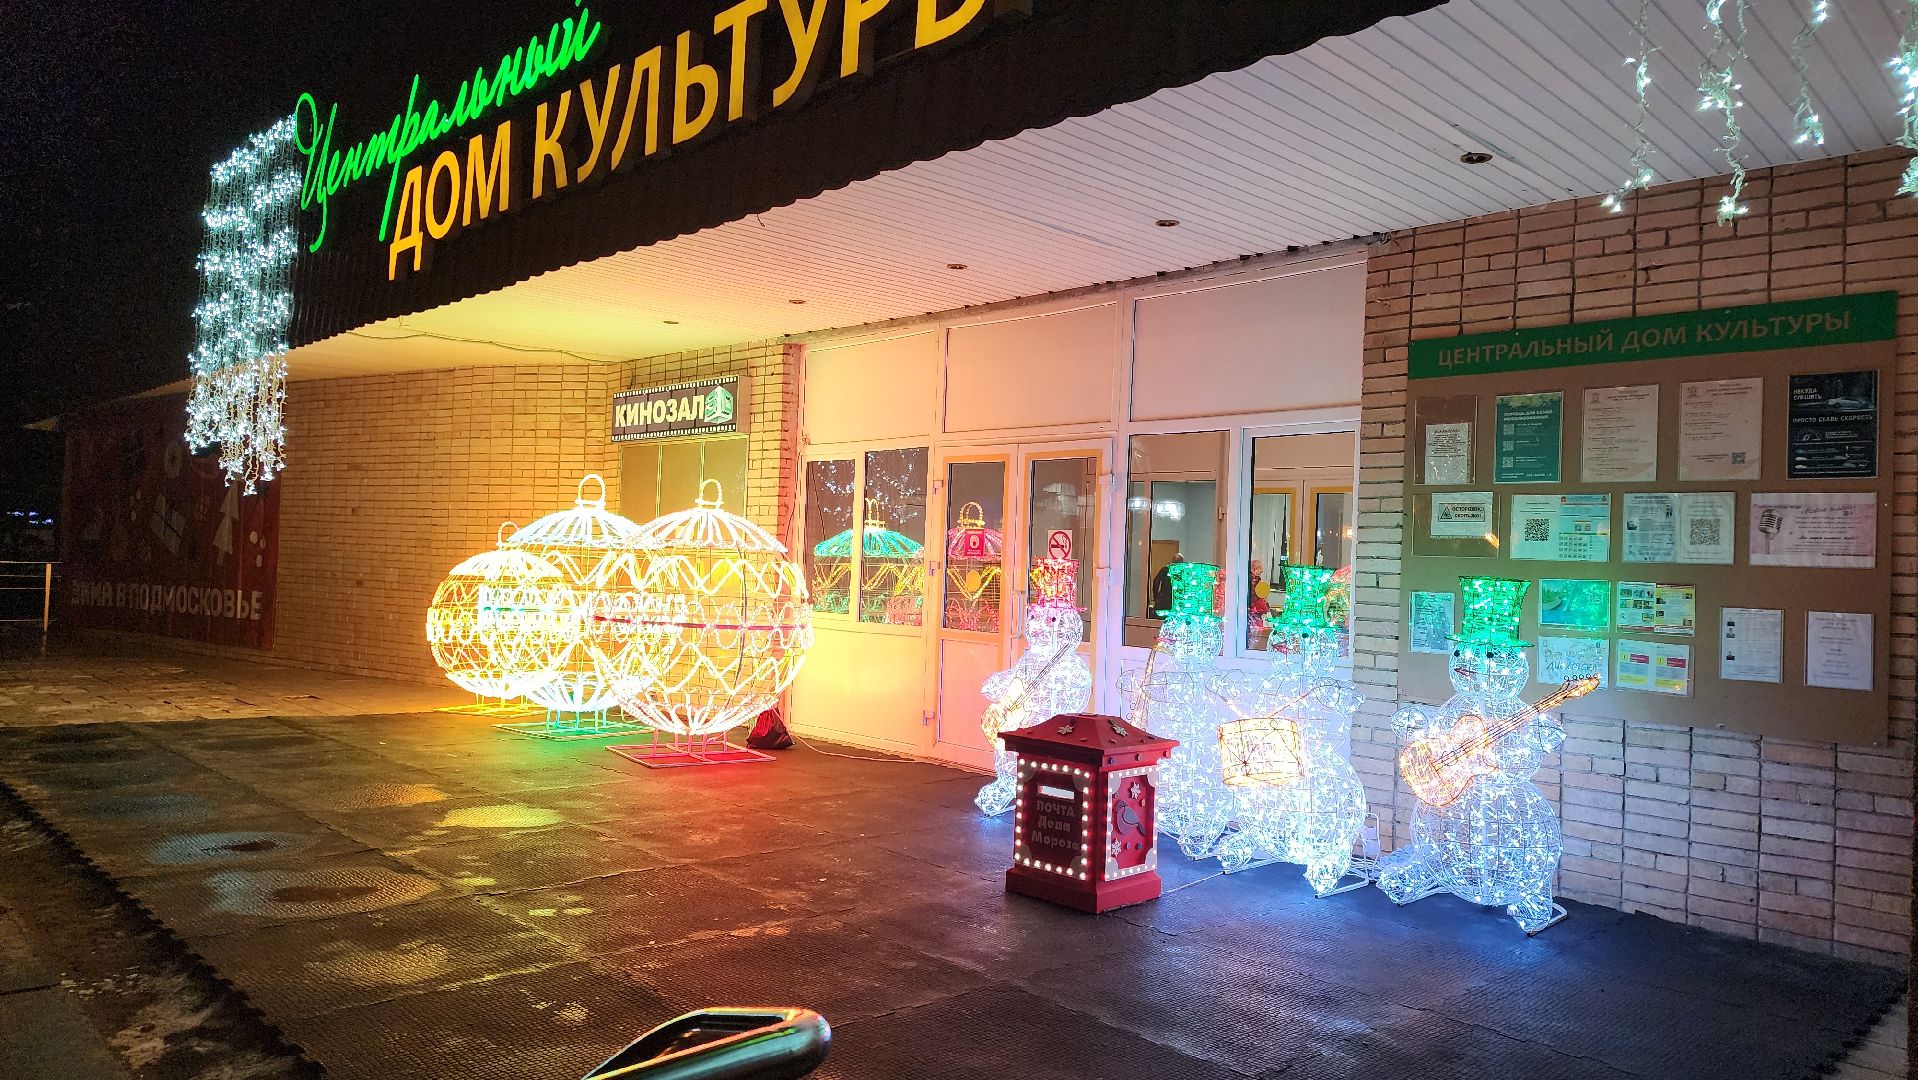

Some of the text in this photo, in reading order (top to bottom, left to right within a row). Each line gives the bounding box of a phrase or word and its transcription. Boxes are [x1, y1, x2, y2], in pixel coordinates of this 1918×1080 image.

[295, 0, 601, 253] Центральный
[388, 120, 512, 281] ДОМ
[1438, 311, 1850, 370] ЦЕНТРАЛЬНЫЙ ДОМ КУЛЬТУРЫ
[1793, 387, 1818, 395] НЕКУДА
[1793, 393, 1823, 401] СПЕШИТЬ
[614, 394, 705, 428] КИНОЗАЛ
[1840, 414, 1873, 422] СКОРОСТЬ
[128, 583, 264, 621] ПОДМОСКОВЬЕ
[1031, 830, 1080, 850] Мороза
